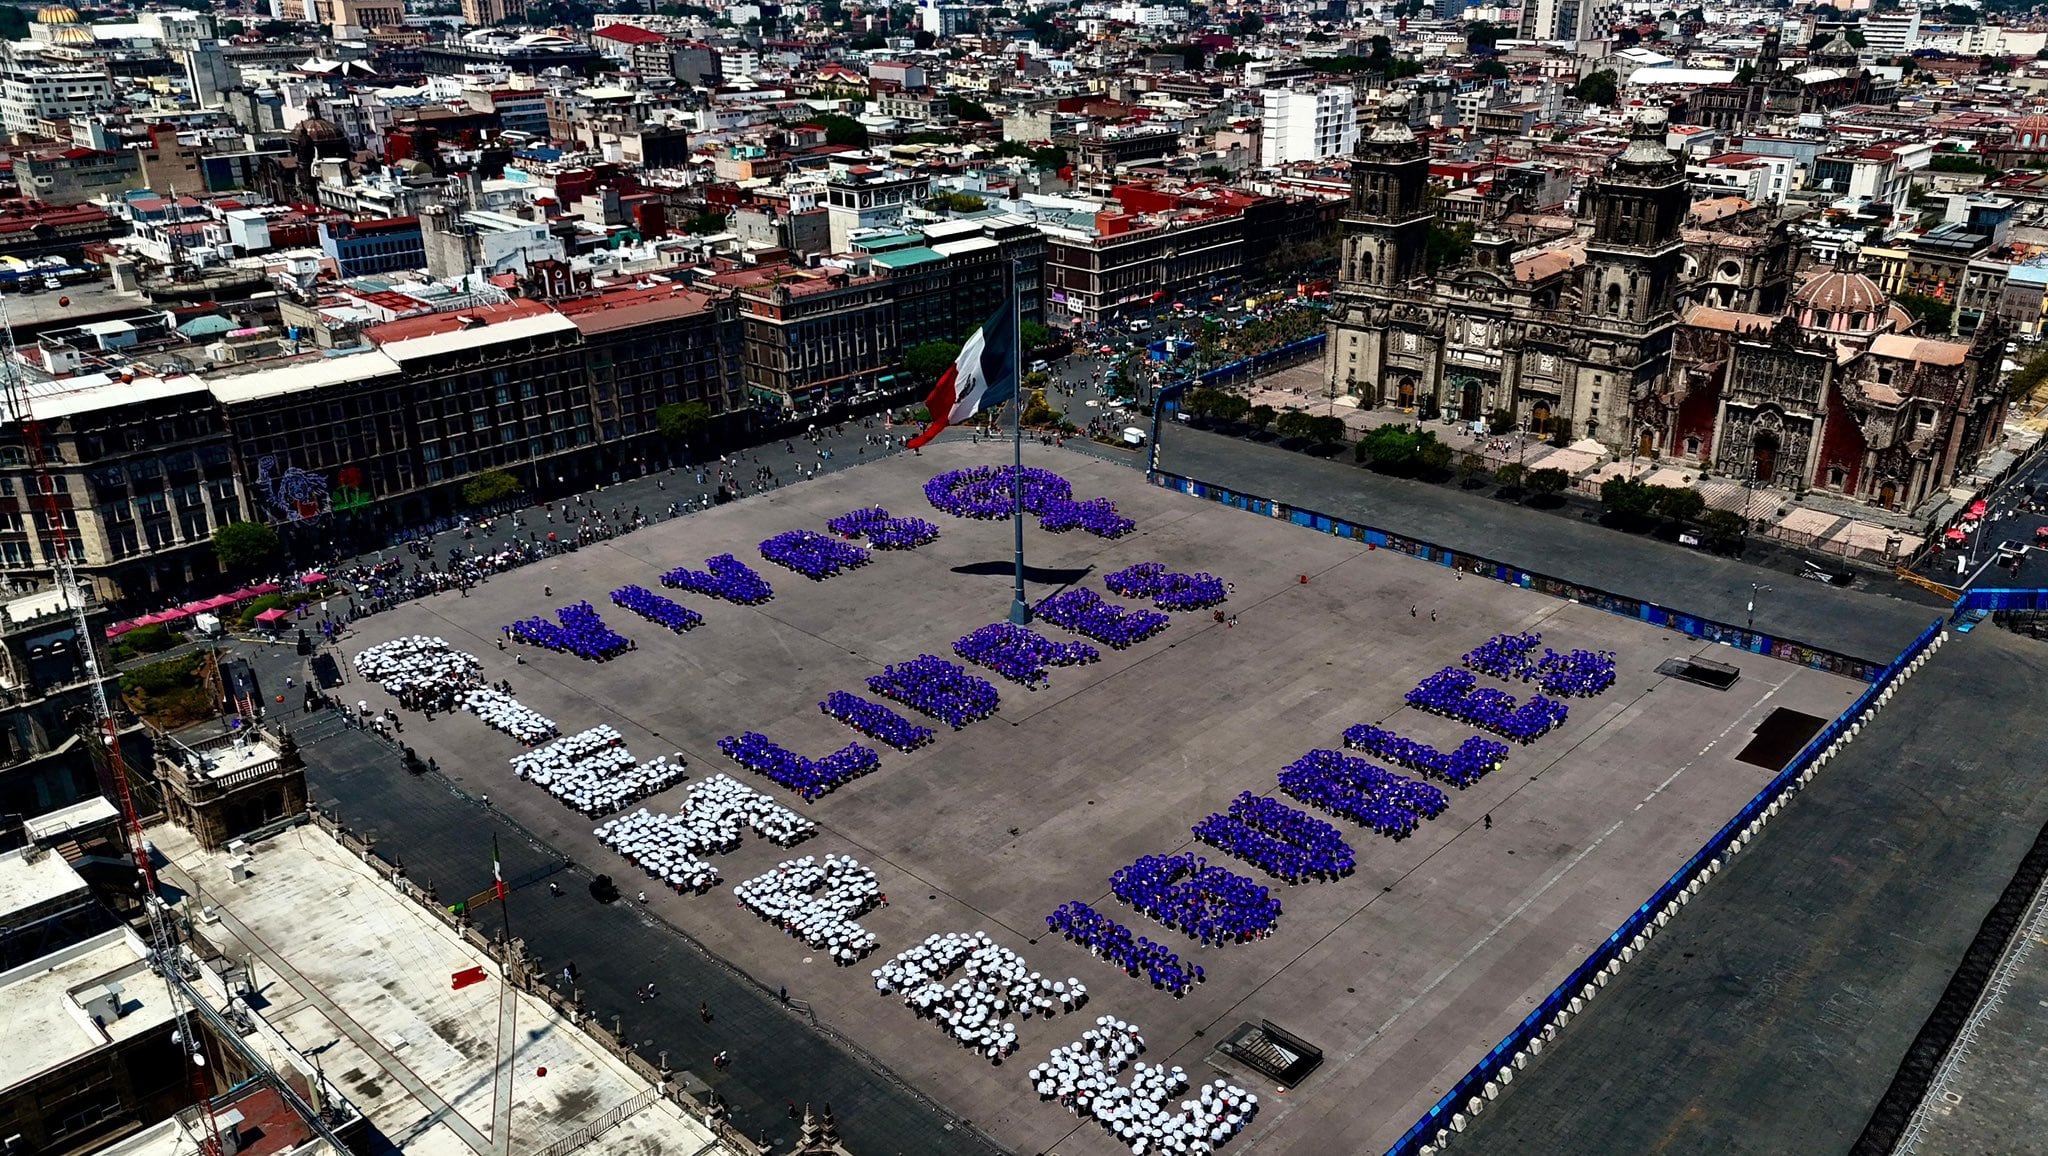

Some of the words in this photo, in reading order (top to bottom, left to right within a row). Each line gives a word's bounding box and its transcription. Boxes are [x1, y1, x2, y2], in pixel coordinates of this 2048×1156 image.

[502, 505, 938, 662] VIVAS
[717, 562, 1228, 802] LIBRES
[352, 634, 1258, 1156] SIEMPRE
[1045, 632, 1616, 999] IGUALES
